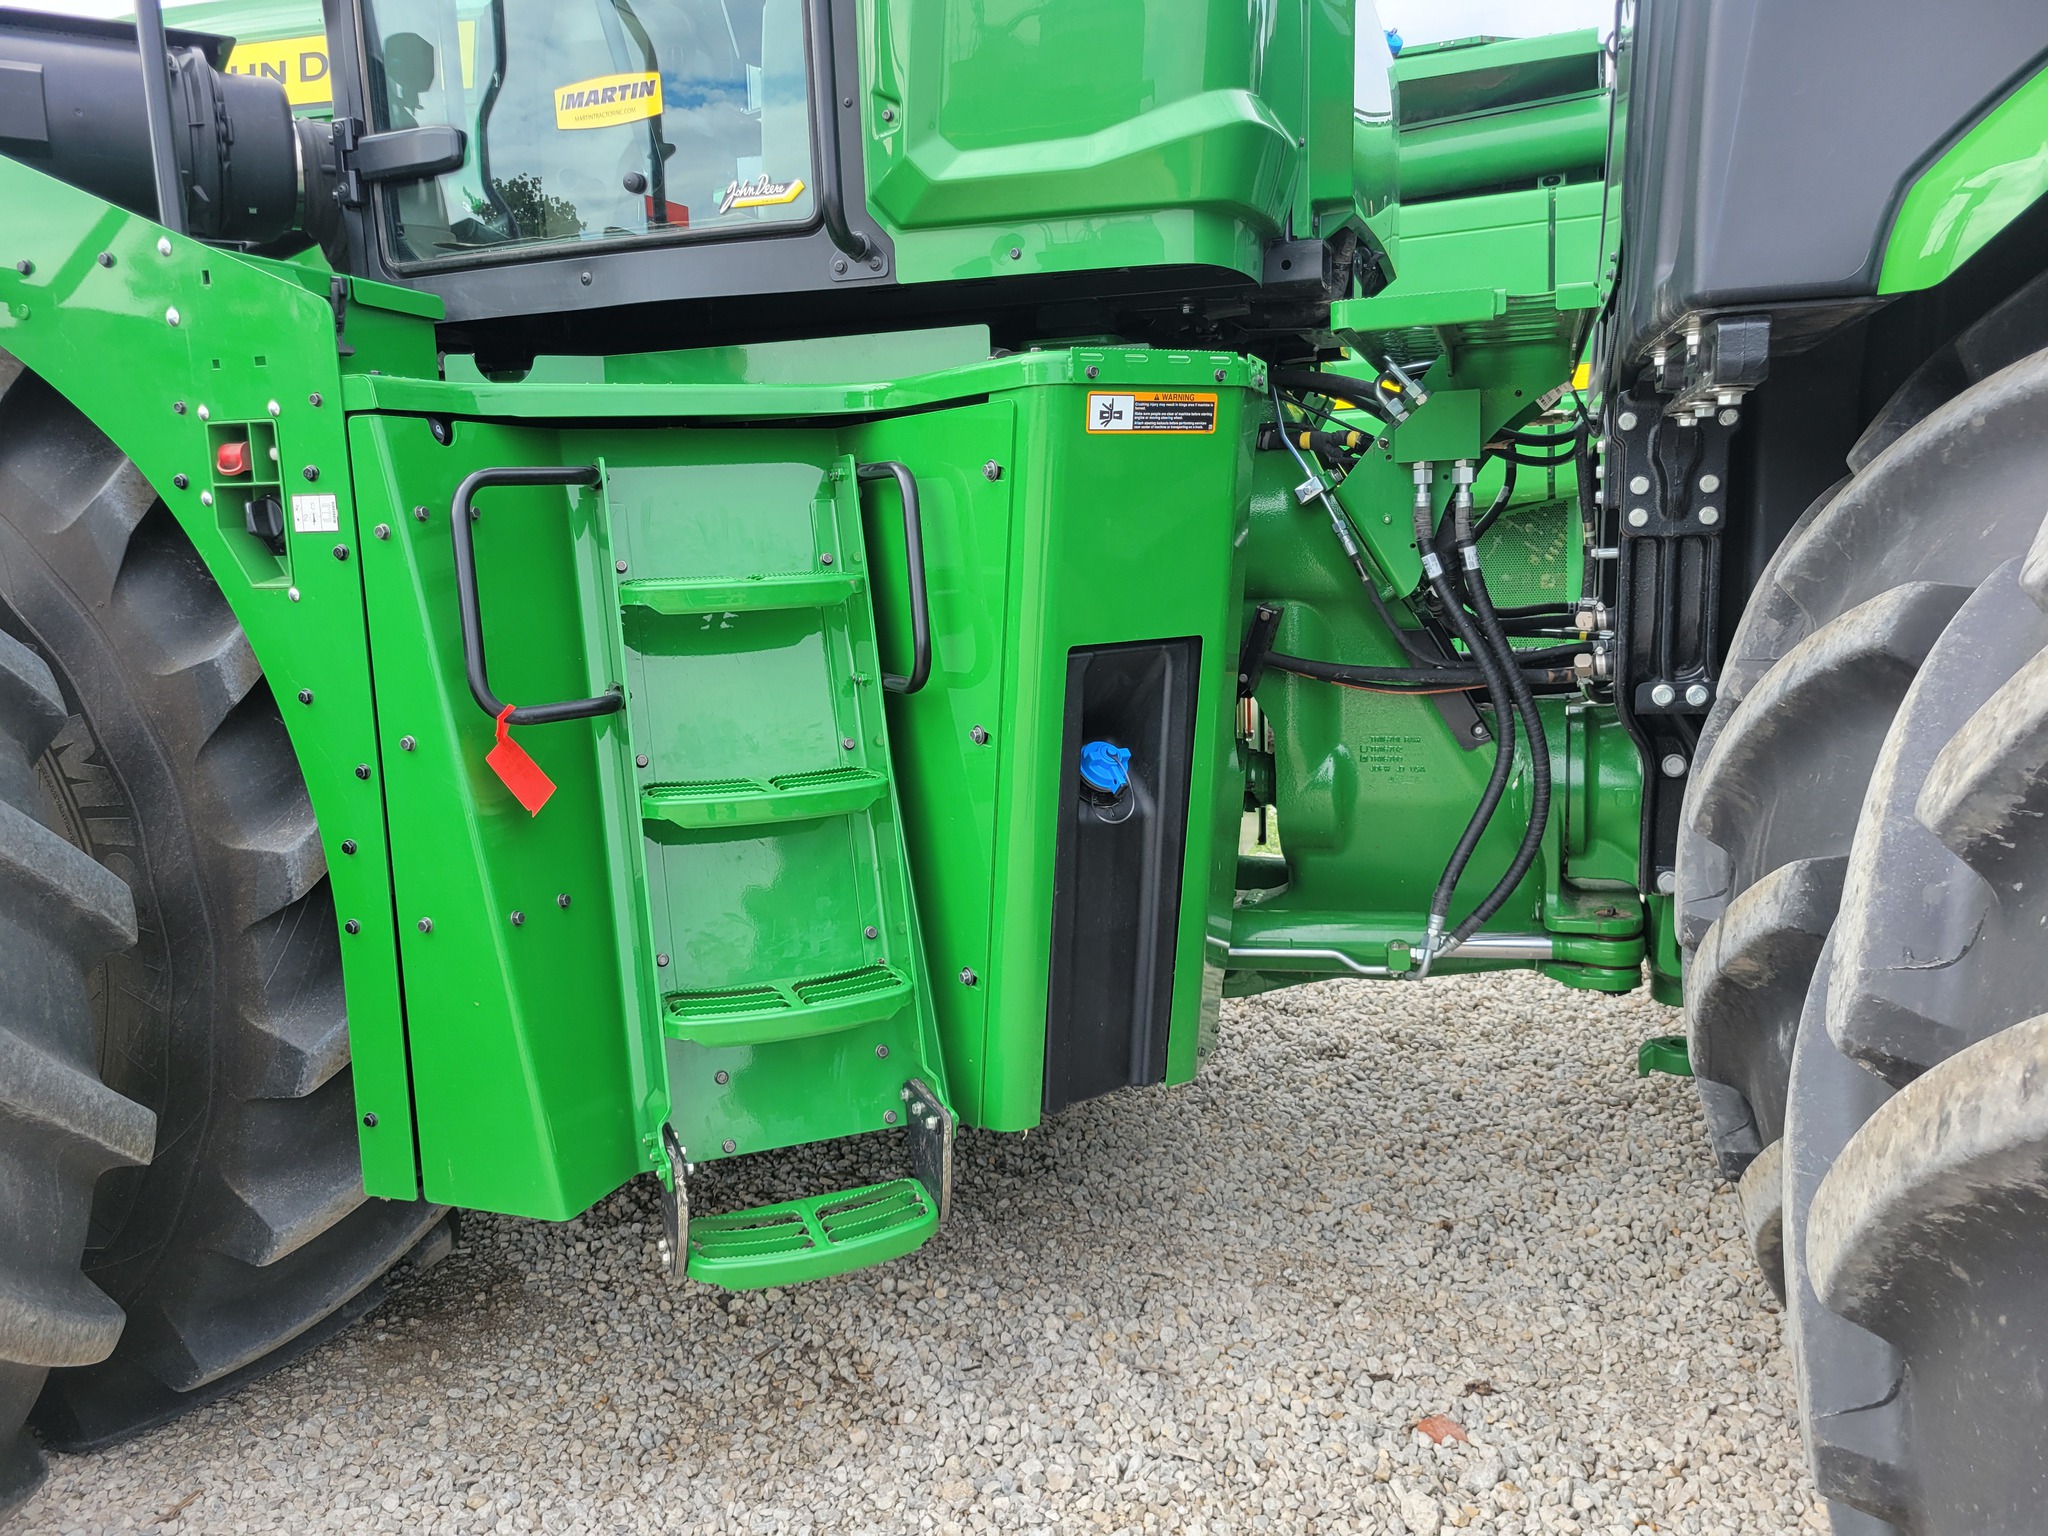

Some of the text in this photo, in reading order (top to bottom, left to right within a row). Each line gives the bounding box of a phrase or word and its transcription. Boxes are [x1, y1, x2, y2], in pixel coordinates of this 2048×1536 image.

[564, 79, 657, 111] MARTIN
[719, 173, 786, 214] John Deere
[1162, 393, 1195, 401] WARNING
